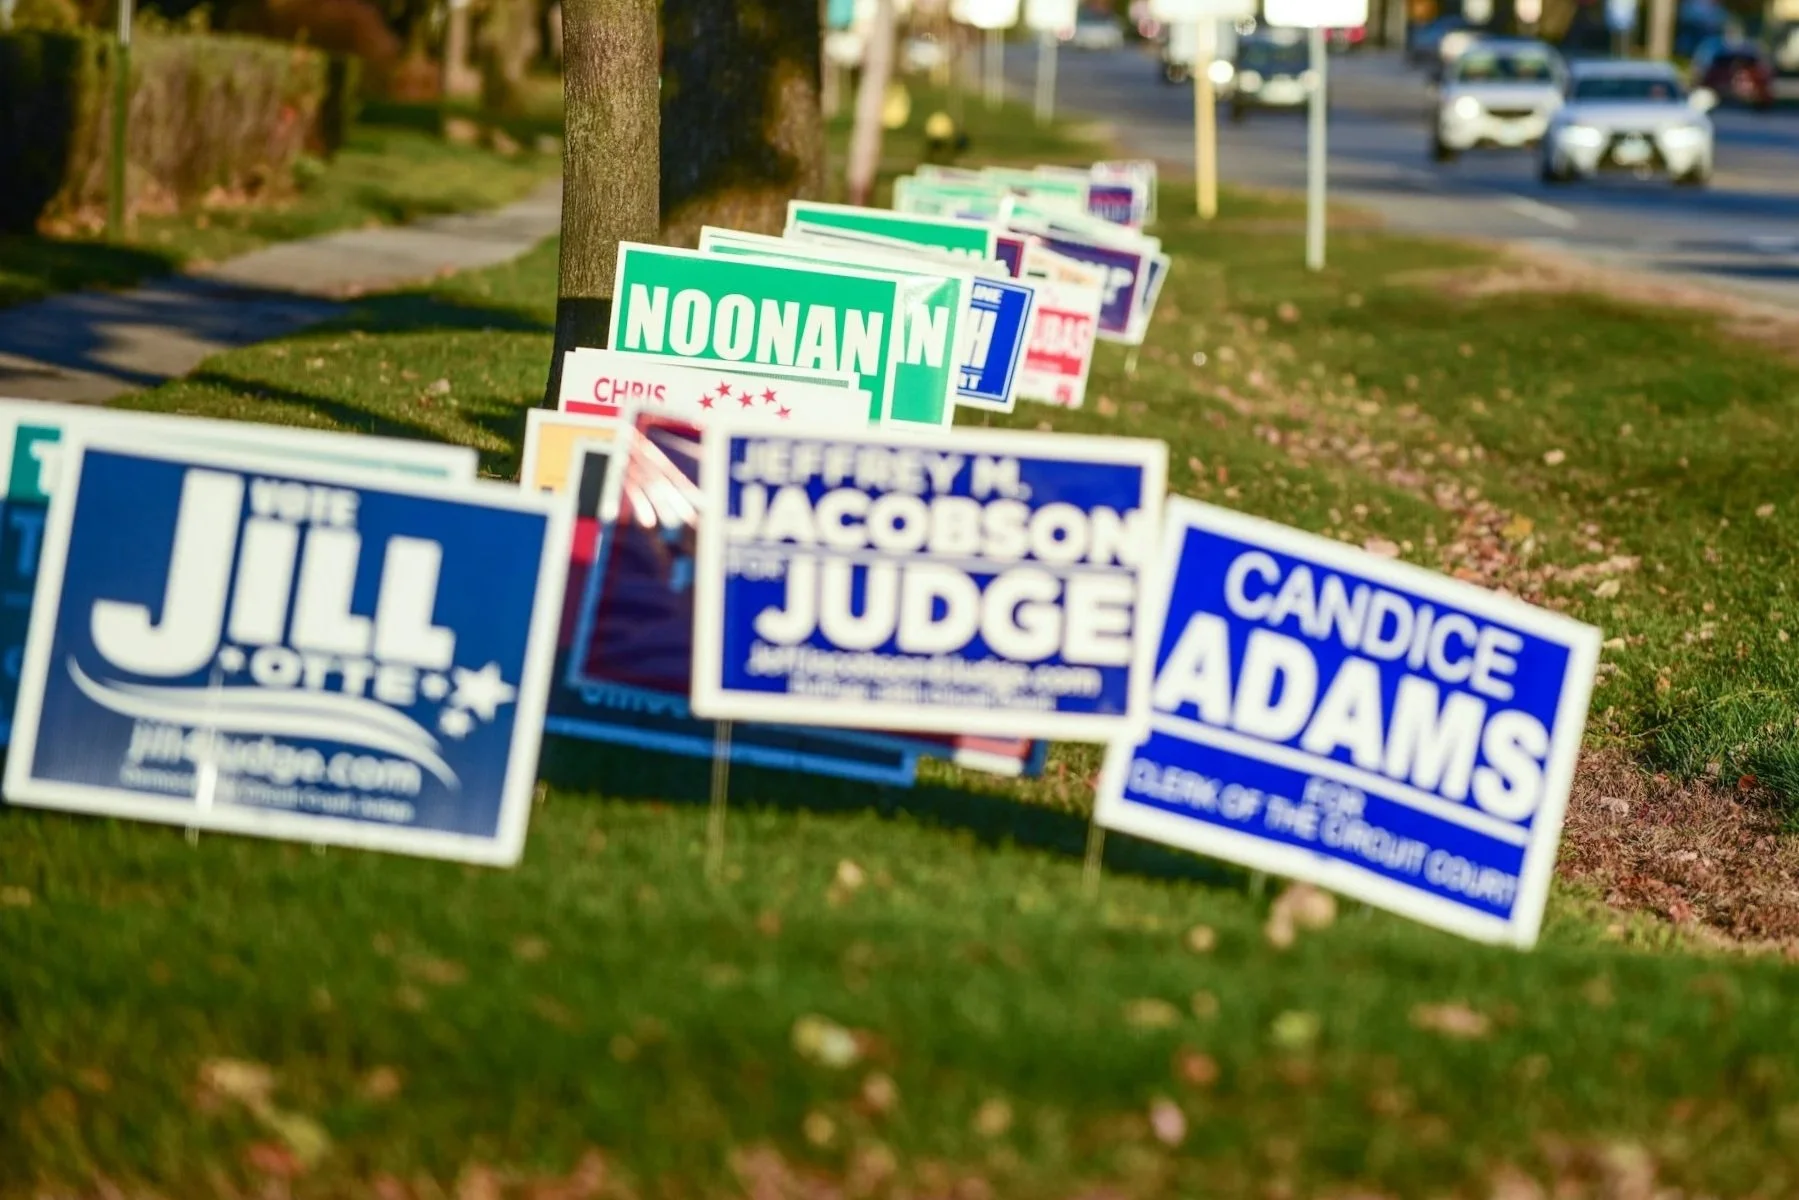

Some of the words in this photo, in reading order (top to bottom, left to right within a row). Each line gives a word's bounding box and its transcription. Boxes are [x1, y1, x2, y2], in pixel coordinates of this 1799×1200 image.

[624, 283, 884, 376] NOONAN
[594, 377, 666, 405] CHRIS
[250, 477, 361, 529] VOTE
[731, 439, 964, 495] JEFFREY
[971, 455, 1033, 501] M.
[725, 484, 1143, 566] JACOBSON
[91, 467, 457, 678] JILL
[753, 553, 1138, 667] JUDGE
[1223, 550, 1524, 702] CANDICE
[250, 645, 419, 707] OTTE
[1152, 610, 1551, 823] ADAMS
[1126, 757, 1222, 813] CLERK
[1218, 782, 1265, 822] OF
[1264, 794, 1322, 842] THE
[1319, 811, 1430, 877] CIRCUIT
[1422, 848, 1521, 910] COURT
[1303, 774, 1367, 819] FOR
